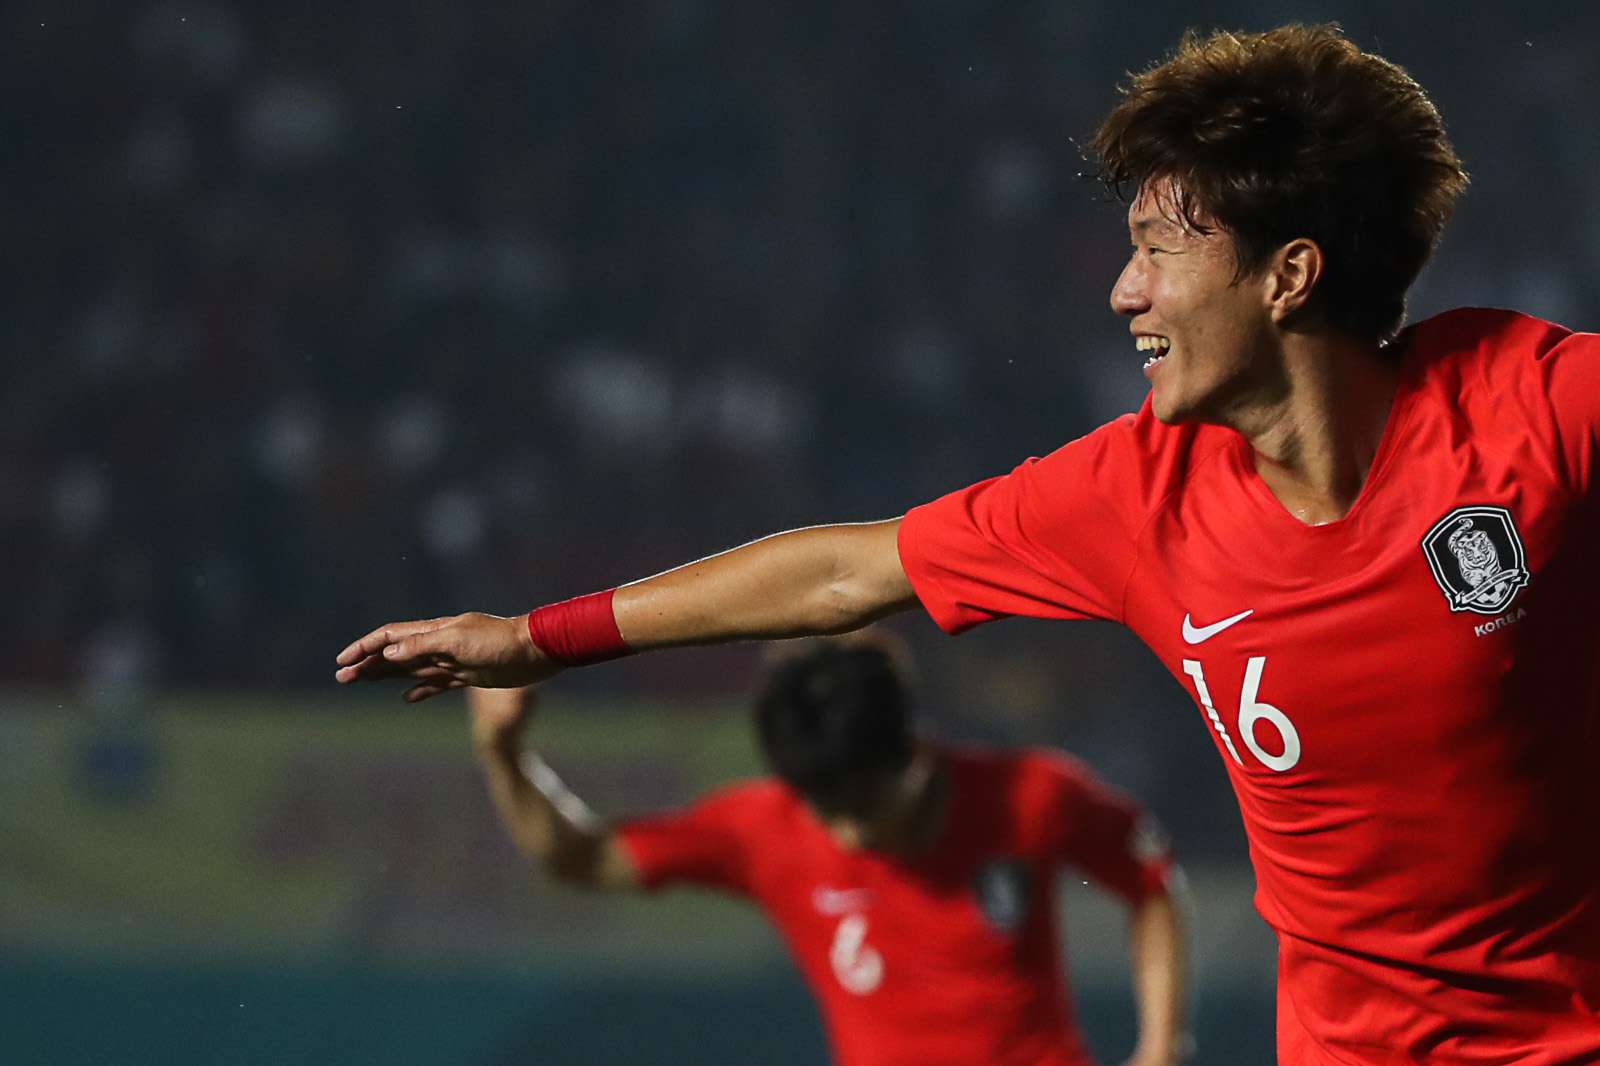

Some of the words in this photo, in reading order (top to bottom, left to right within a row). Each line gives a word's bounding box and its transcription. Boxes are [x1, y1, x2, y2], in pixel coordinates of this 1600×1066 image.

[1474, 607, 1526, 637] KOREA
[1181, 656, 1301, 773] 16
[829, 911, 886, 995] 6
